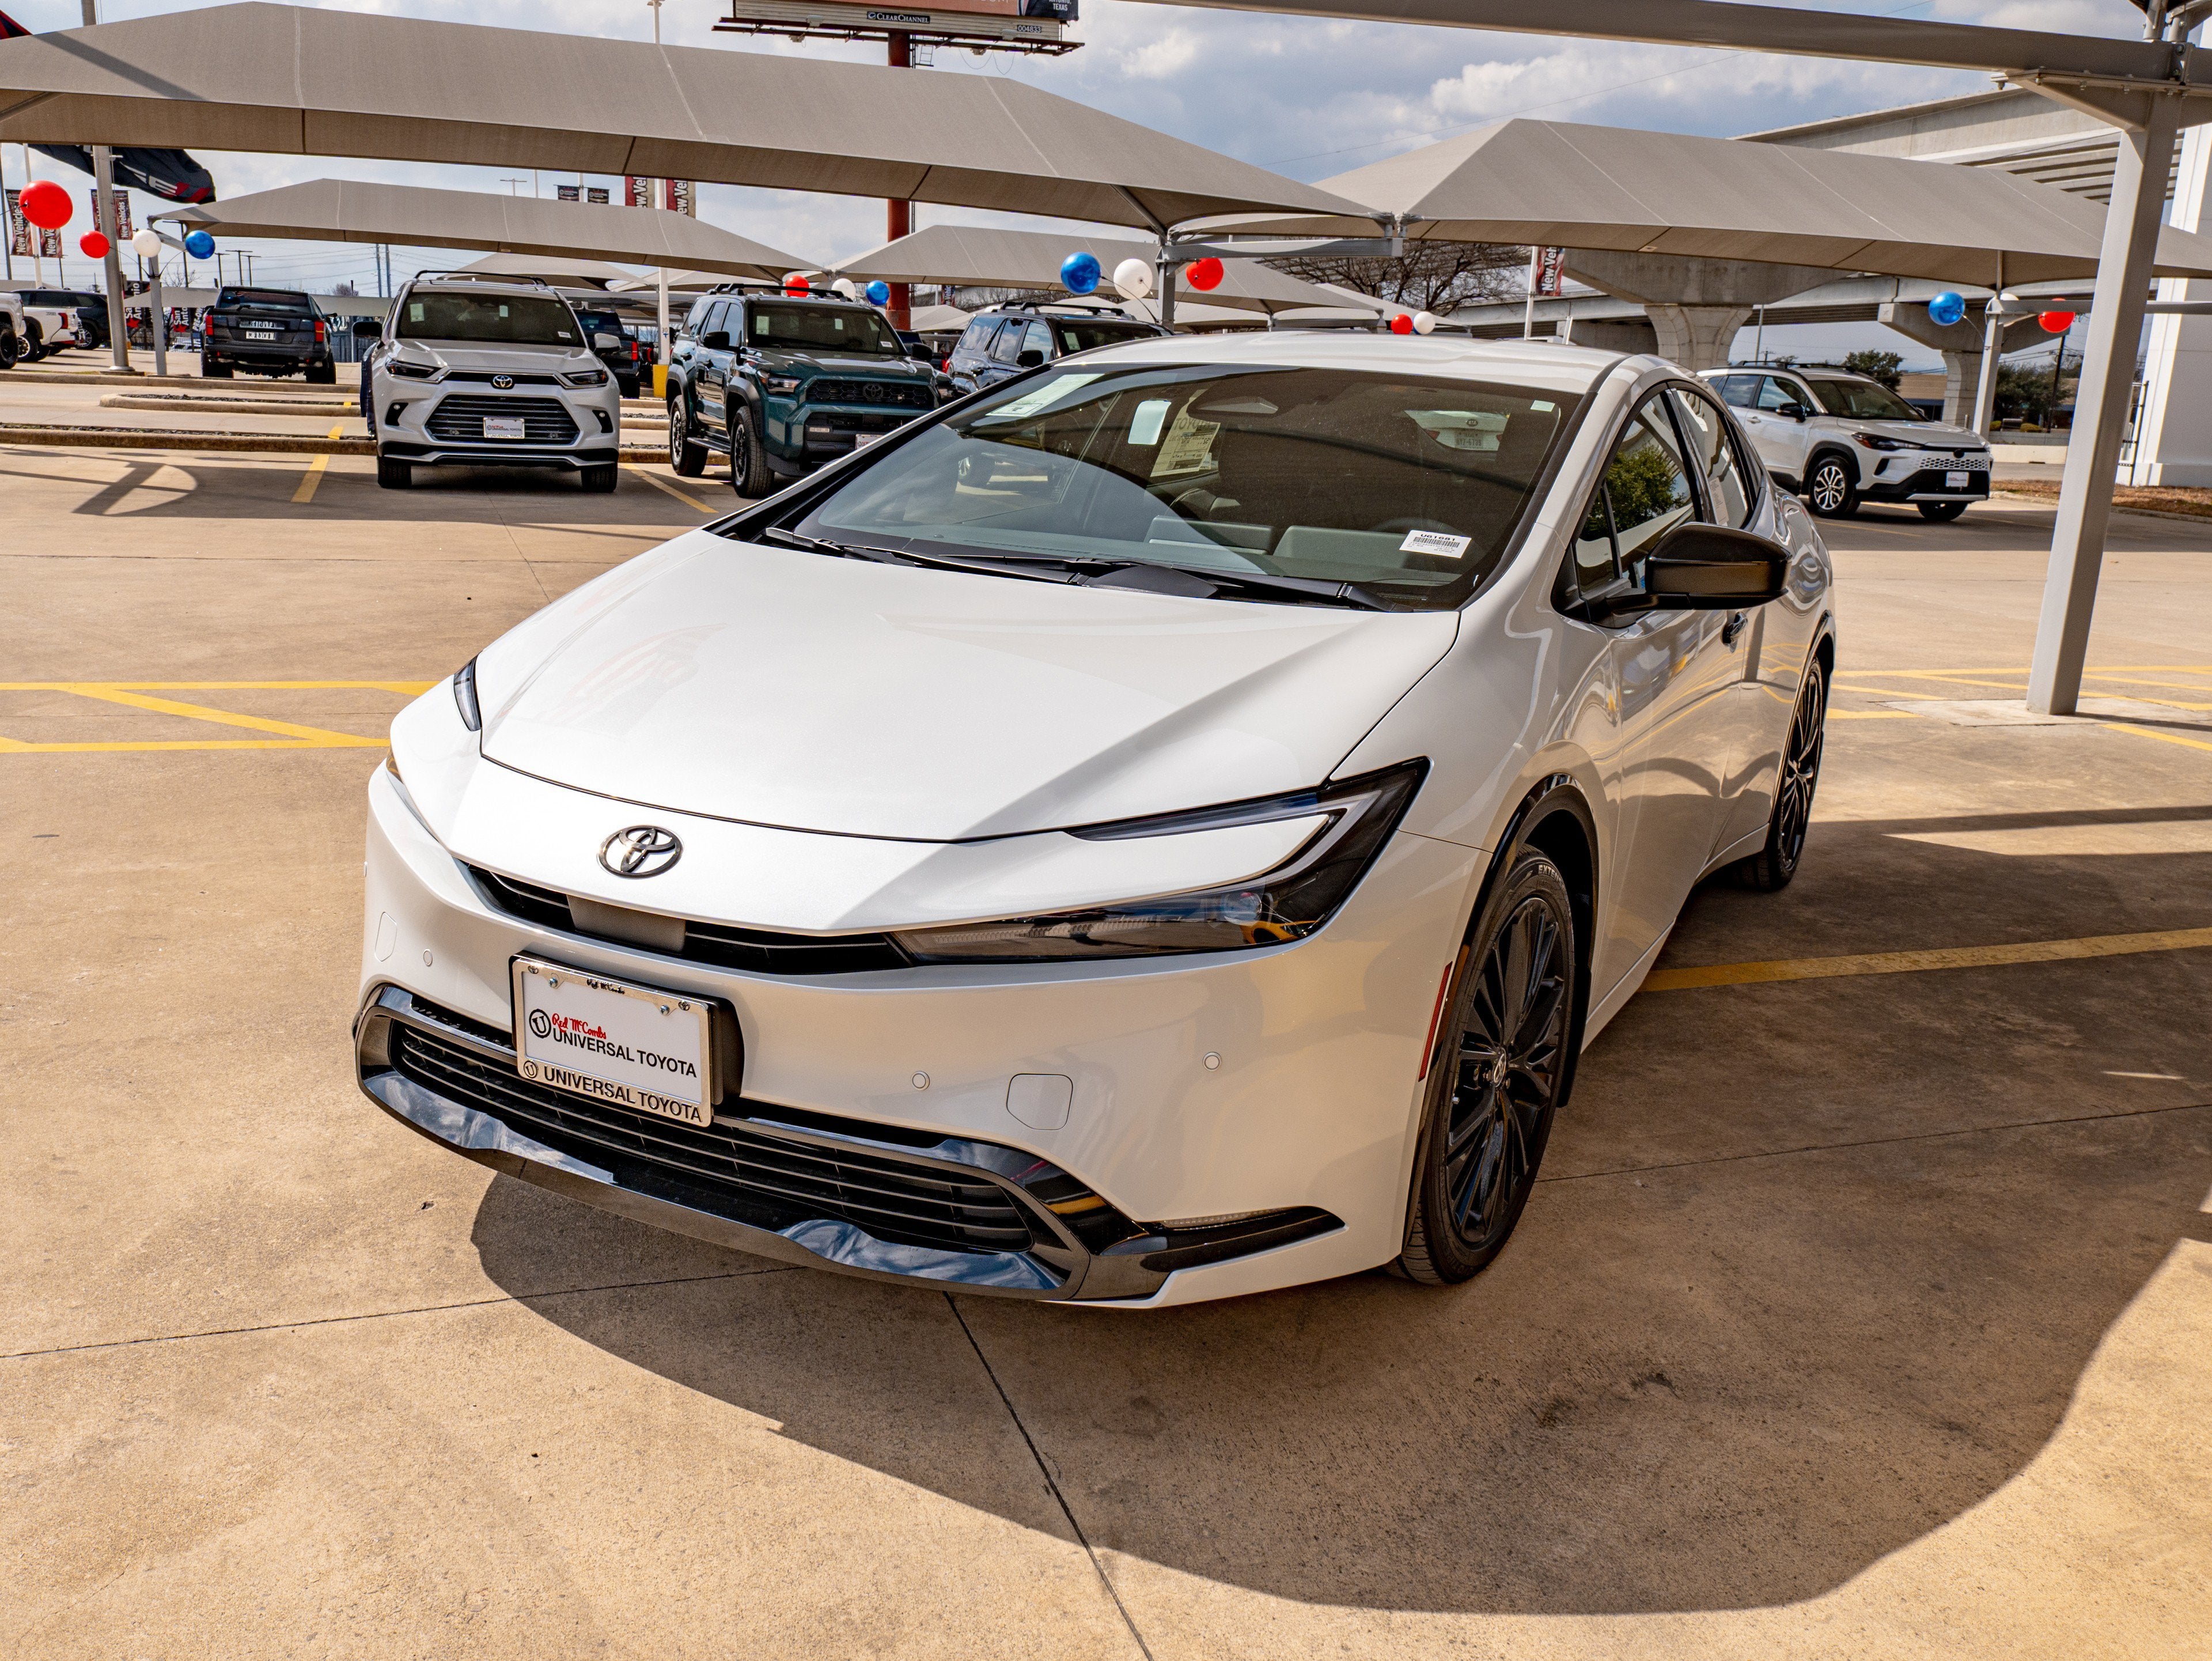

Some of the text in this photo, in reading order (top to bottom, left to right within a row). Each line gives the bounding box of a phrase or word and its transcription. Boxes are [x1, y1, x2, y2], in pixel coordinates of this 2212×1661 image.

[1053, 3, 1068, 11] TEXAS
[1018, 25, 1041, 33] 004833
[118, 202, 127, 224] Vehicles
[677, 198, 688, 214] ew
[16, 237, 26, 253] New
[46, 238, 56, 254] New
[1541, 268, 1554, 291] New
[125, 307, 133, 319] Sa
[173, 310, 181, 325] San
[551, 1012, 569, 1033] Red
[553, 1027, 697, 1079] UNIVERSAL TOYOTA
[544, 1065, 703, 1123] UNIVERSAL TOYOTA
